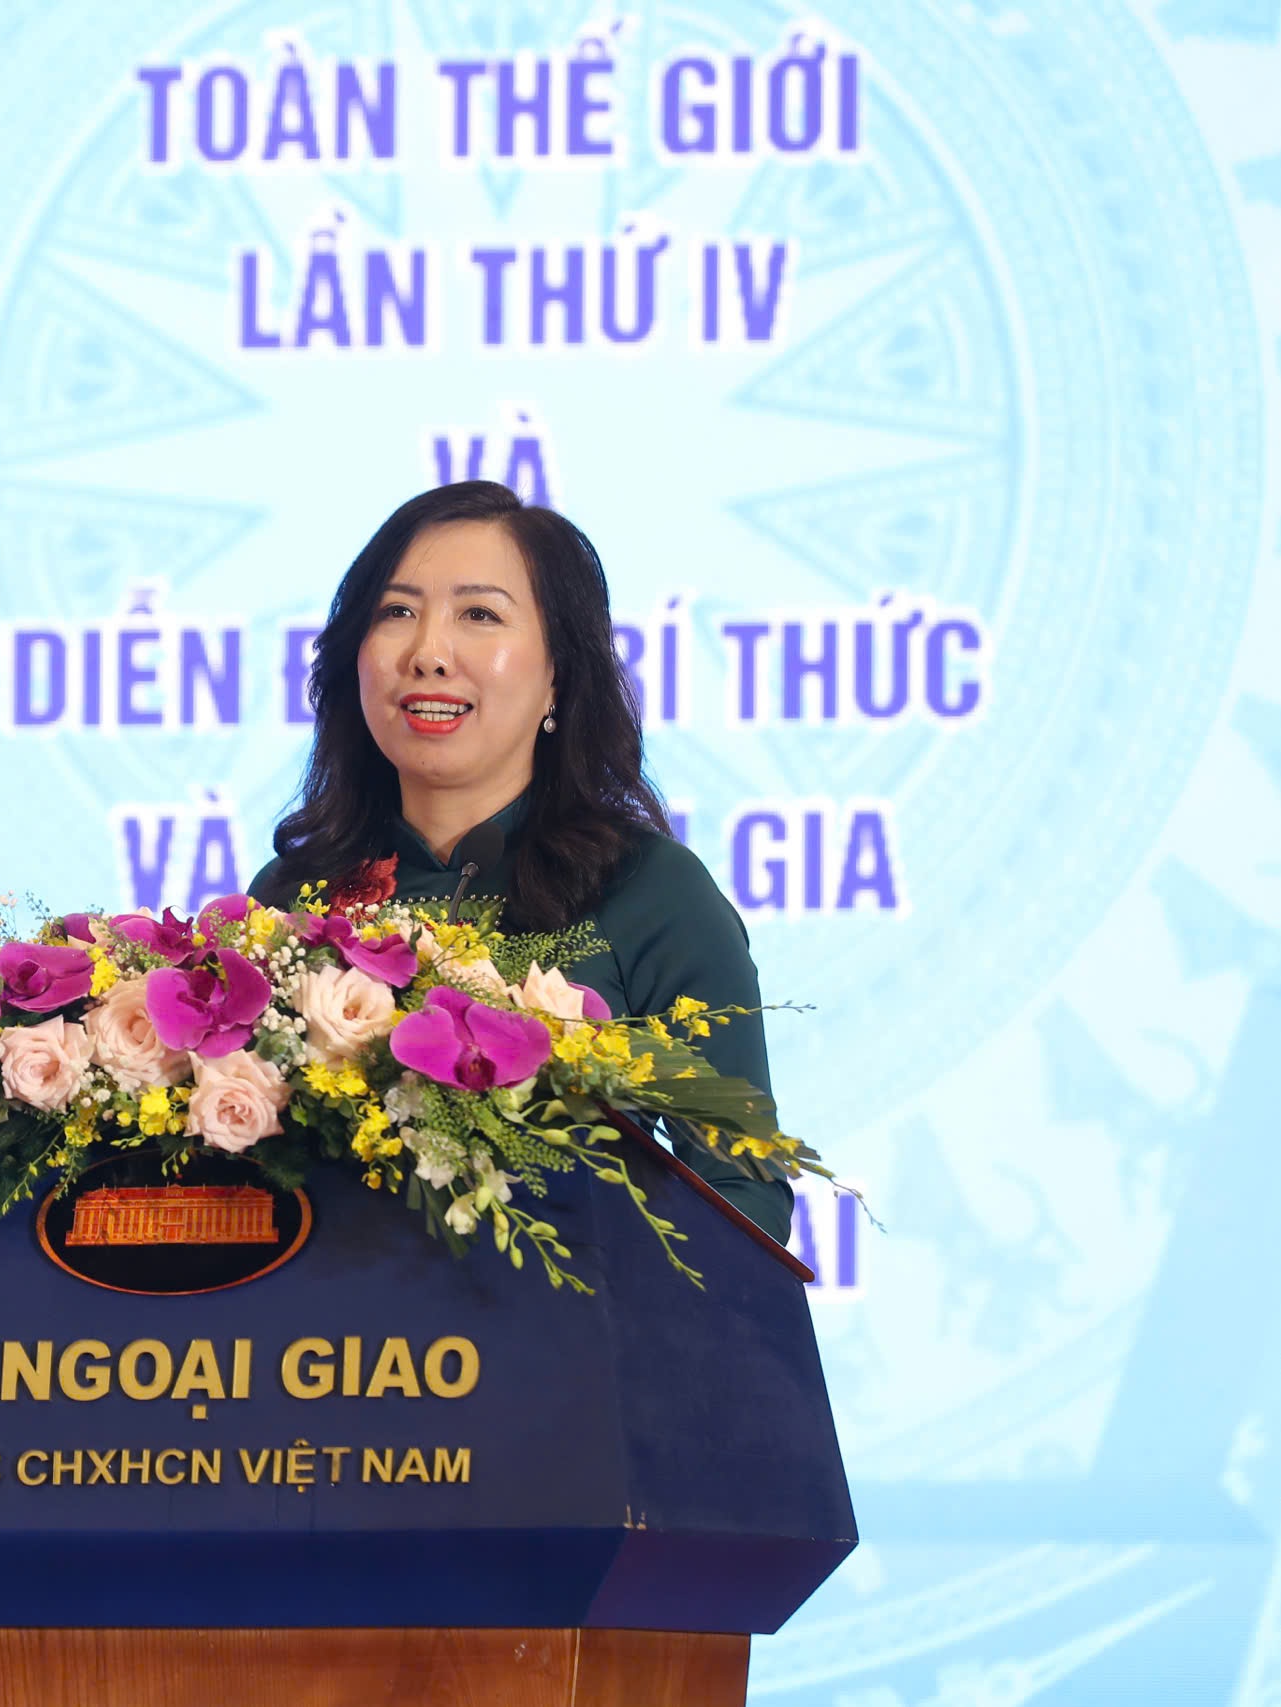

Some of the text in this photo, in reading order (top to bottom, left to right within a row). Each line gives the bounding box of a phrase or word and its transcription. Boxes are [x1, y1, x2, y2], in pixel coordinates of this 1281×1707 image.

[137, 19, 859, 163] TOÀN THẾ GIỚI
[240, 209, 787, 349] LẦN THỨ IV
[13, 587, 242, 726] DIỄN
[722, 594, 982, 720] THỨC
[122, 788, 898, 913] VÀ GIA
[0, 1338, 253, 1420] NGOẠI
[281, 1335, 481, 1400] GIAO
[16, 1448, 222, 1486] CHXHCN
[238, 1437, 352, 1493] VIỆT
[361, 1447, 471, 1484] NAM
